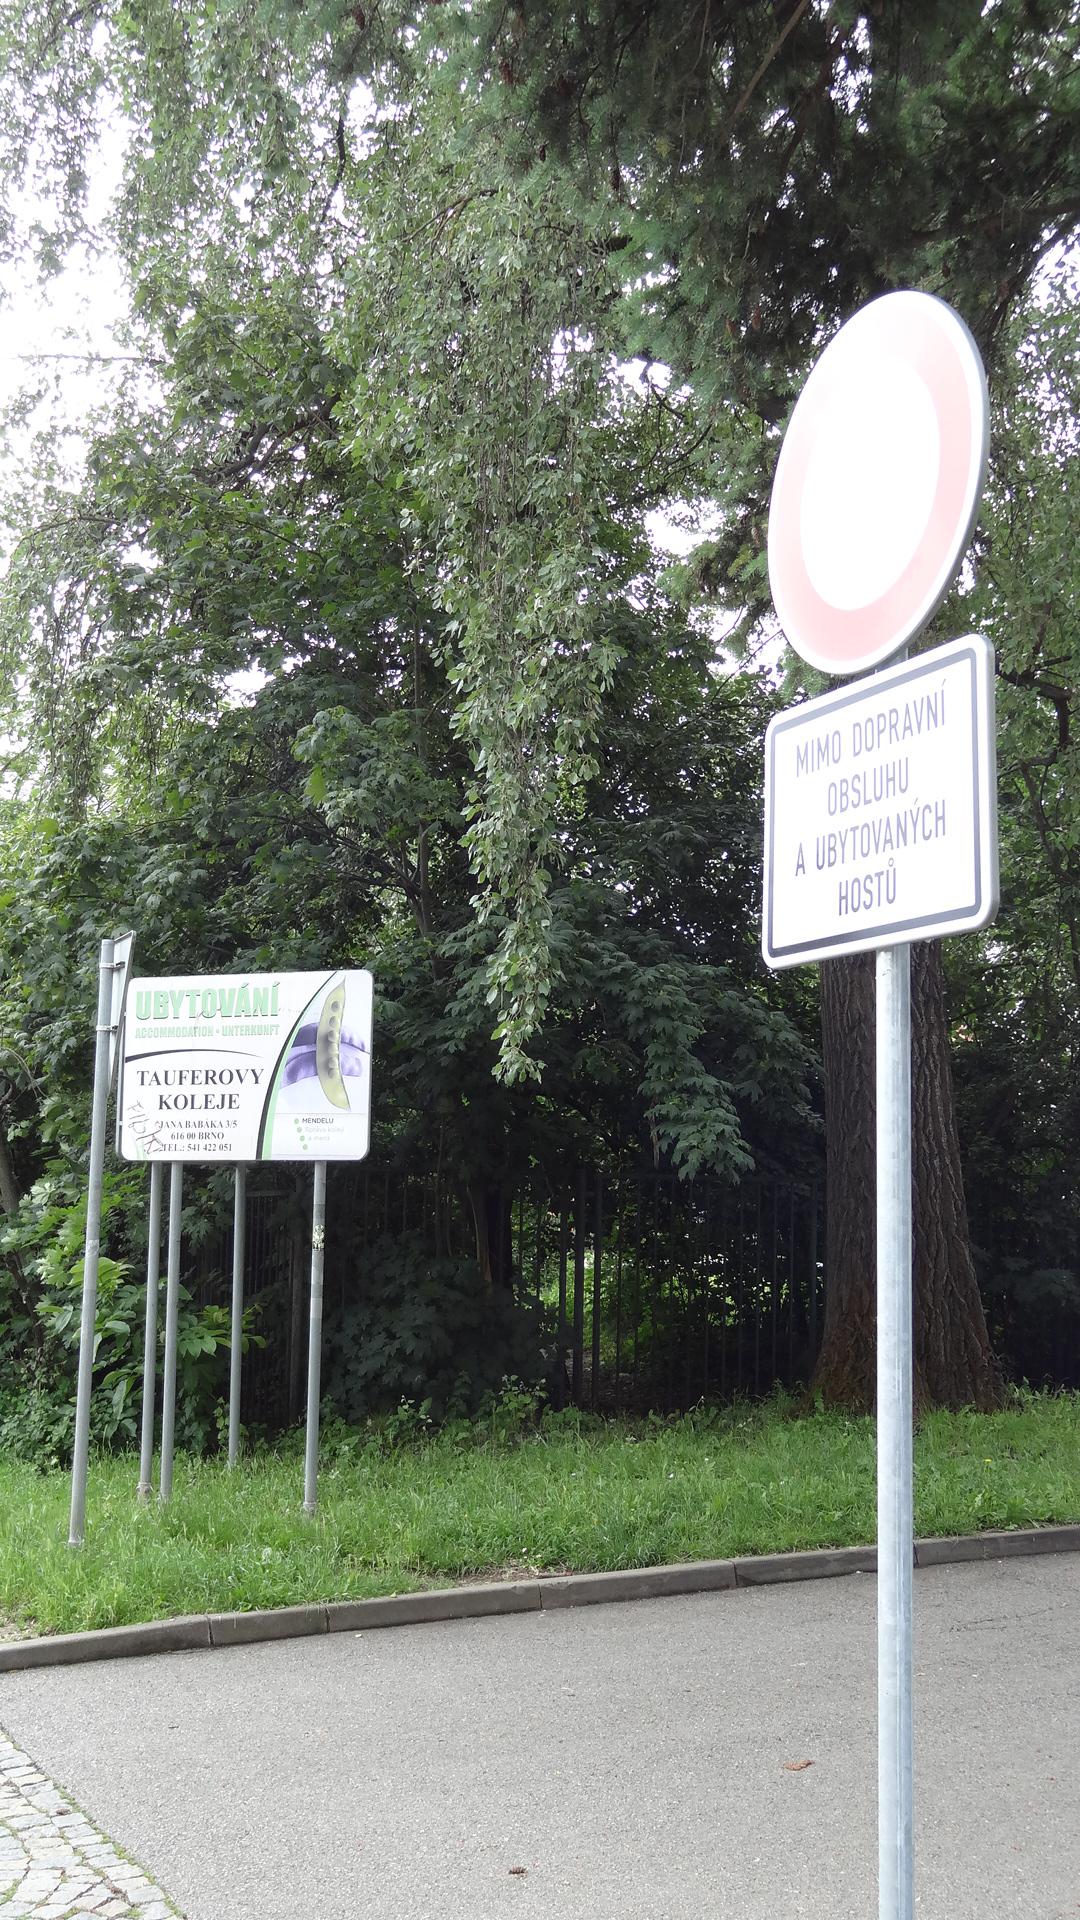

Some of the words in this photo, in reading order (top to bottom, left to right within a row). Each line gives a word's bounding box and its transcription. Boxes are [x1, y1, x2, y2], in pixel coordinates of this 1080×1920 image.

[796, 729, 842, 778] MIMO
[852, 678, 946, 757] DOPRAVNÍ
[827, 757, 909, 816] OBSLUHU
[795, 843, 806, 877] A
[816, 797, 946, 870] UBYTOVANÝCH
[838, 858, 897, 916] HOSTŮ
[135, 981, 281, 1020] UBYTOVÁNÍ
[135, 1026, 214, 1039] ACCOMMODATION
[221, 1024, 280, 1037] UNTERKUNFT
[136, 1068, 265, 1087] TAUFEROVY
[157, 1093, 241, 1111] KOLEJE
[159, 1120, 184, 1129] JANA
[185, 1118, 223, 1129] BABÁKA
[225, 1119, 238, 1129] 3/5
[170, 1131, 186, 1141] 616
[186, 1131, 197, 1141] 00
[198, 1131, 225, 1141] BRNO
[187, 1143, 200, 1152] 541
[203, 1143, 217, 1152] 422
[218, 1143, 233, 1152] 051
